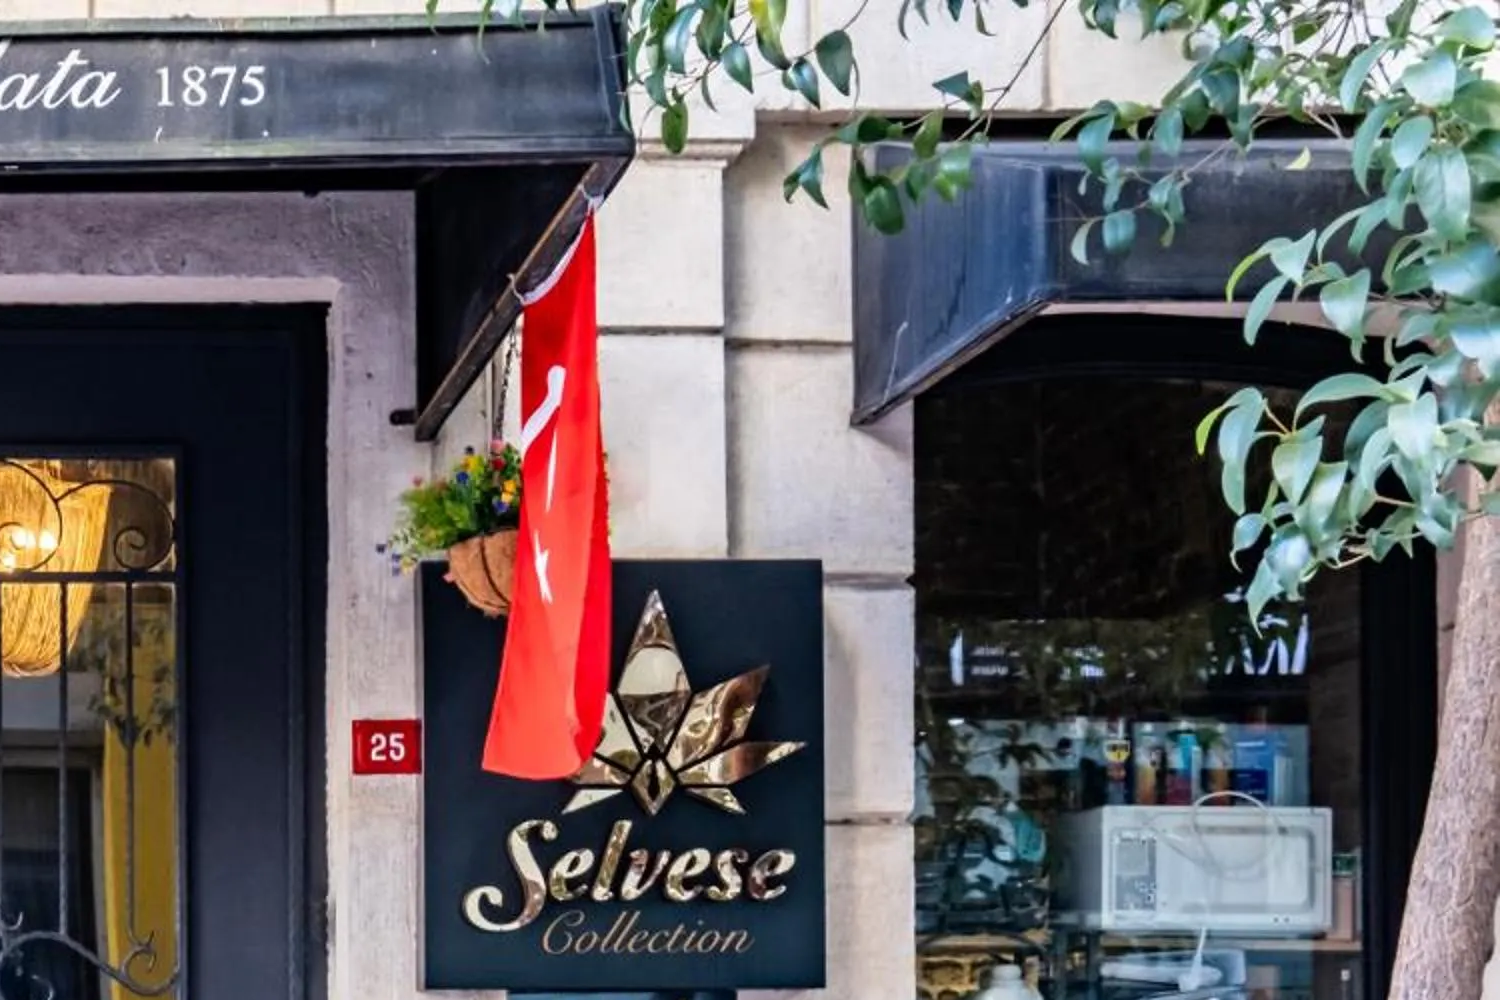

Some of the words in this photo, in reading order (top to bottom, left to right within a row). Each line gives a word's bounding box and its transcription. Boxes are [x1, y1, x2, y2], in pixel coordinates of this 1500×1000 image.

[155, 65, 266, 107] 1875
[371, 733, 405, 761] 25
[462, 819, 796, 930] Selvese
[542, 910, 753, 954] Collection
